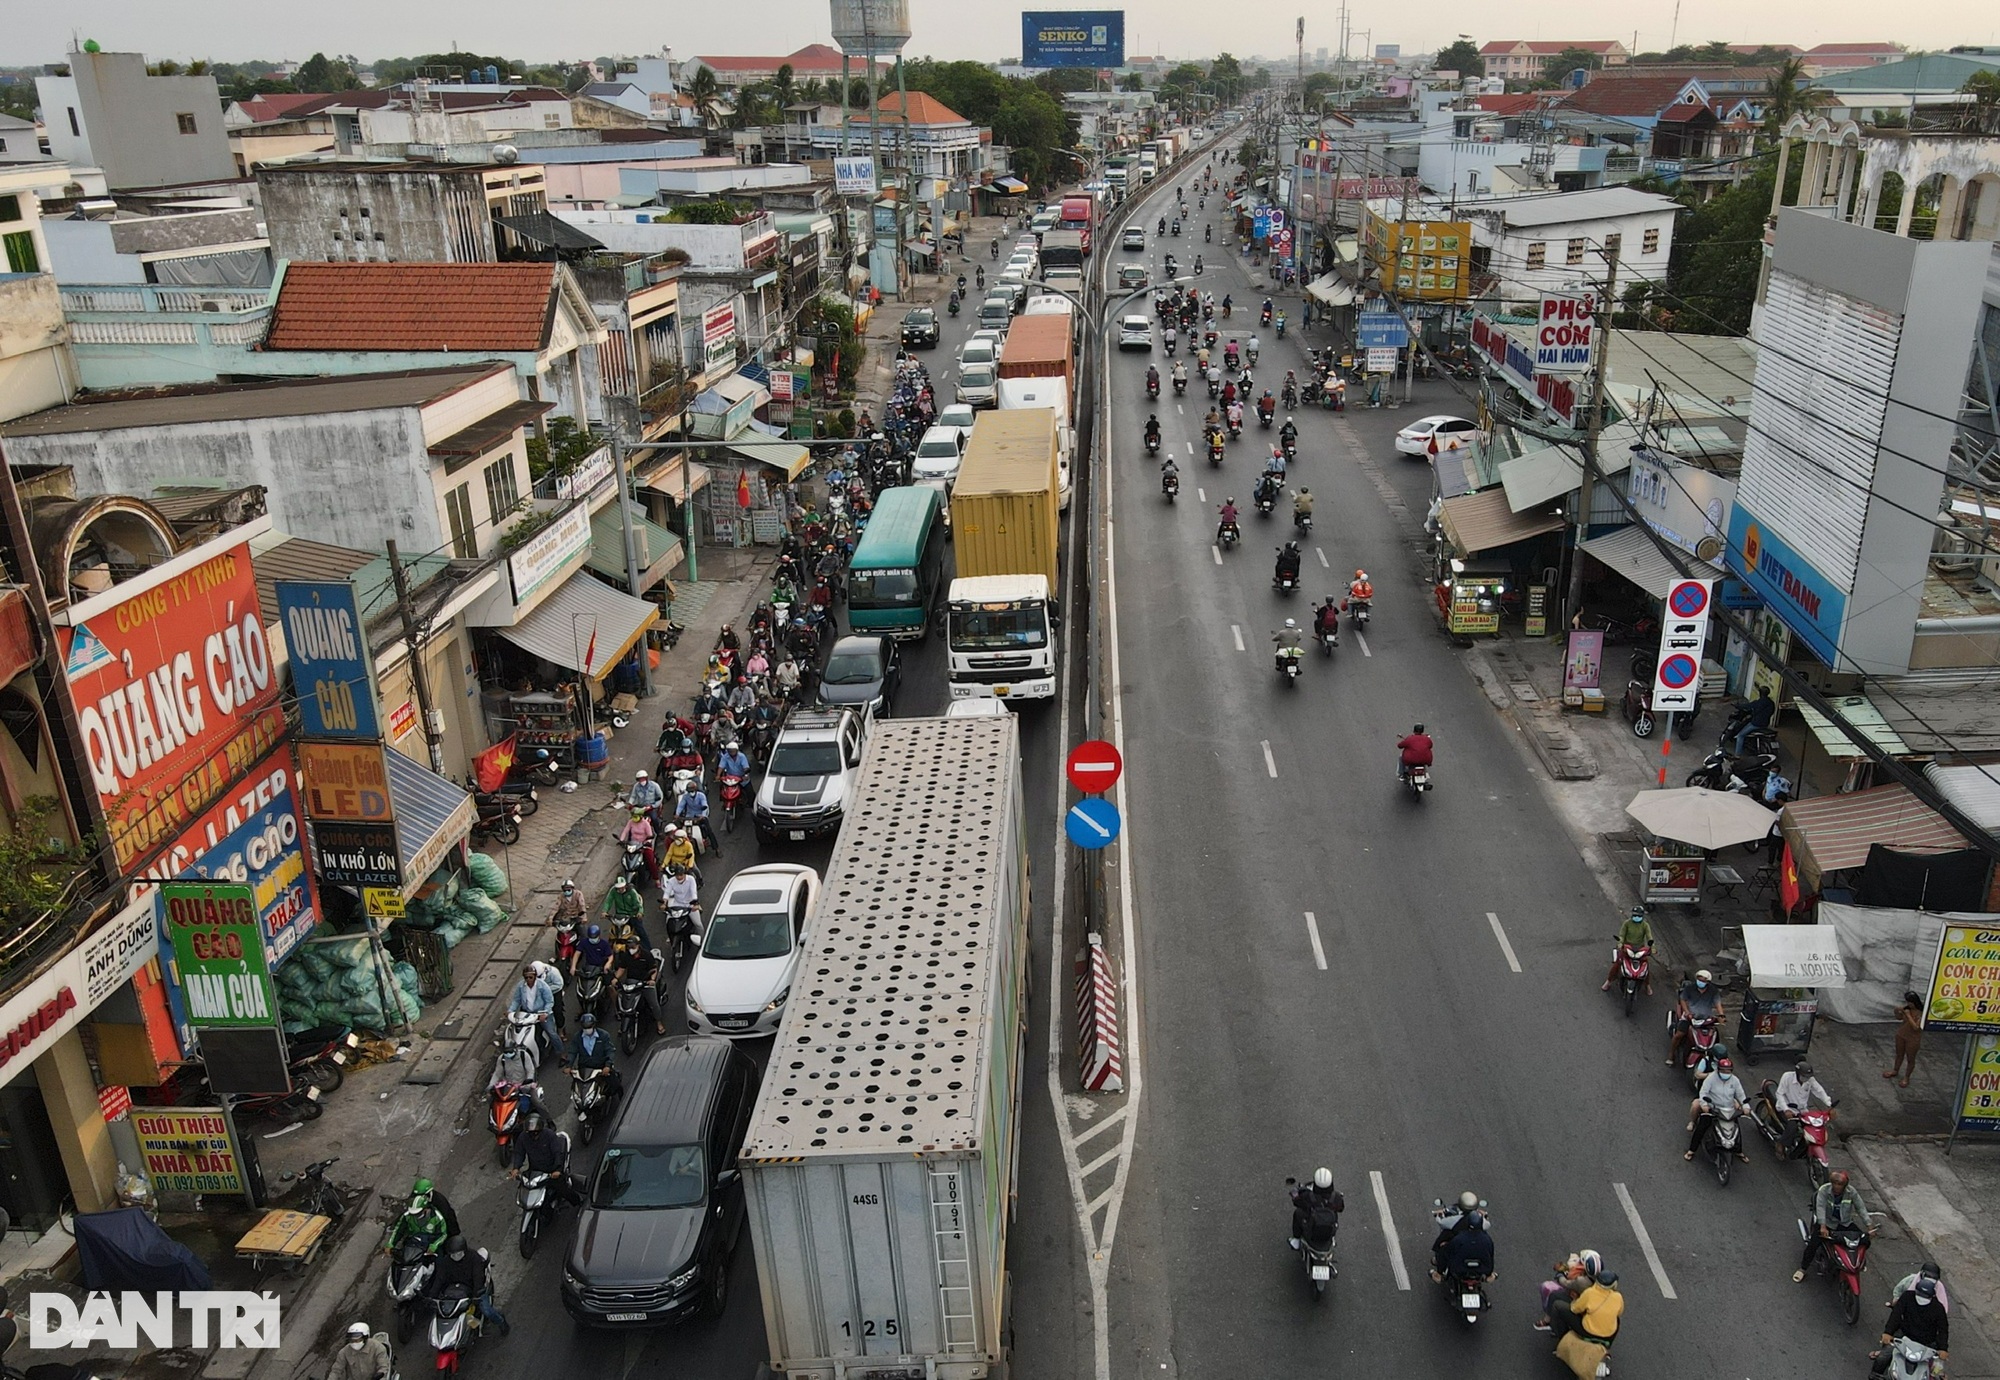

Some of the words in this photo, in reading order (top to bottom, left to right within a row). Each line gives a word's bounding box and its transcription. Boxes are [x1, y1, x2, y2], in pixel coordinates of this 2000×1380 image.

[1038, 31, 1087, 41] SENKO
[837, 160, 853, 179] NHÀ
[855, 158, 873, 179] NGHỈ
[1543, 293, 1594, 321] PHỞ
[1540, 321, 1591, 346] CƠM
[1538, 349, 1557, 363] HAI
[168, 574, 191, 607] TY
[1761, 547, 1821, 621] VIETBANK
[288, 590, 358, 665] QUẢNG
[80, 648, 206, 795] QUẢNG
[204, 600, 269, 715] CÁO
[315, 670, 357, 731] CÁO
[306, 748, 353, 788] Quảng
[353, 754, 384, 786] Cáo
[312, 788, 386, 817] LED
[339, 847, 366, 870] KHỔ
[370, 851, 396, 871] LỚN
[356, 872, 397, 883] LAZER
[169, 889, 256, 928] QUẢNG
[88, 948, 115, 983] ANH
[118, 917, 152, 957] DŨNG
[192, 927, 243, 960] CÁO
[1946, 945, 1983, 960] CÔNG
[1800, 963, 1840, 977] SAIGON
[1943, 962, 1976, 979] CƠM
[185, 965, 230, 1018] MÀN
[228, 959, 269, 1019] CỬA
[1941, 981, 1961, 998] GÀ
[1965, 981, 1994, 999] XỐI
[137, 1115, 175, 1135] GIỚI
[176, 1115, 226, 1138] THIỆU
[146, 1140, 168, 1150] MUA
[170, 1139, 189, 1150] BÁN
[148, 1151, 192, 1173] NHÀ
[195, 1150, 232, 1173] ĐẤT
[156, 1175, 175, 1190] ĐT:
[175, 1175, 195, 1190] 092
[195, 1175, 221, 1190] 6789
[222, 1175, 238, 1190] 113
[853, 1194, 878, 1205] 44SG
